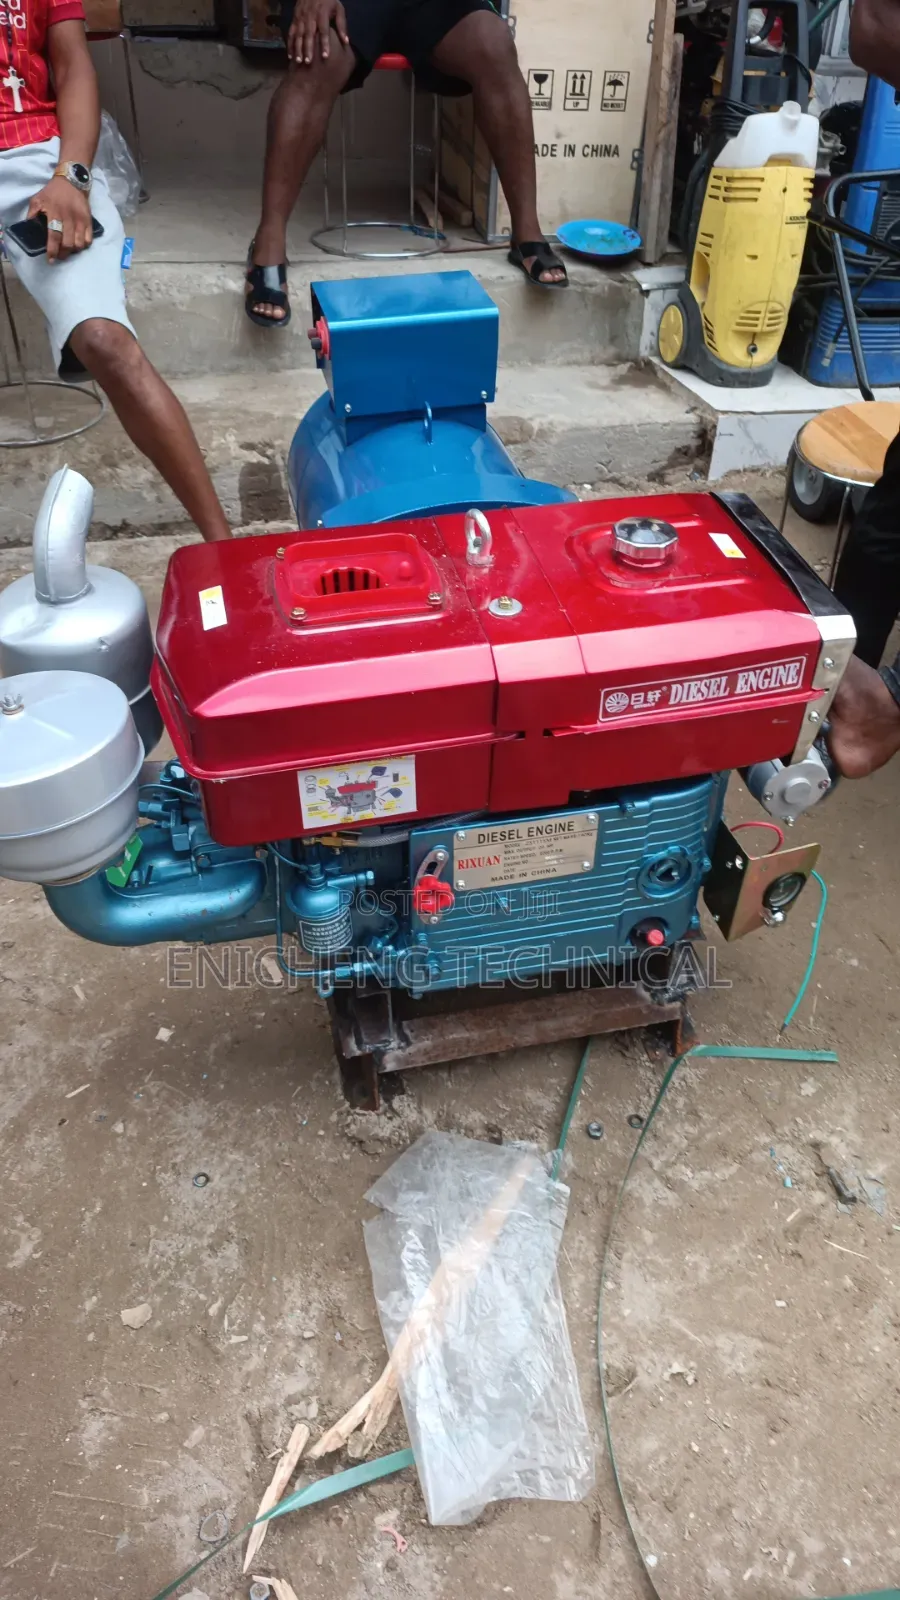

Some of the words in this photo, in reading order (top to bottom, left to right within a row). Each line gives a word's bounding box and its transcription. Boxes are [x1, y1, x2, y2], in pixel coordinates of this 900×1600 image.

[534, 143, 557, 158] ADE
[563, 143, 576, 158] IN
[581, 144, 620, 158] CHINA
[668, 676, 730, 705] DIESEL
[734, 662, 801, 695] ENGINE
[477, 829, 523, 844] DIESEL
[527, 821, 575, 838] ENGINE
[457, 854, 502, 870] RIXUAN
[490, 873, 515, 883] MADE
[531, 868, 557, 877] CHINA
